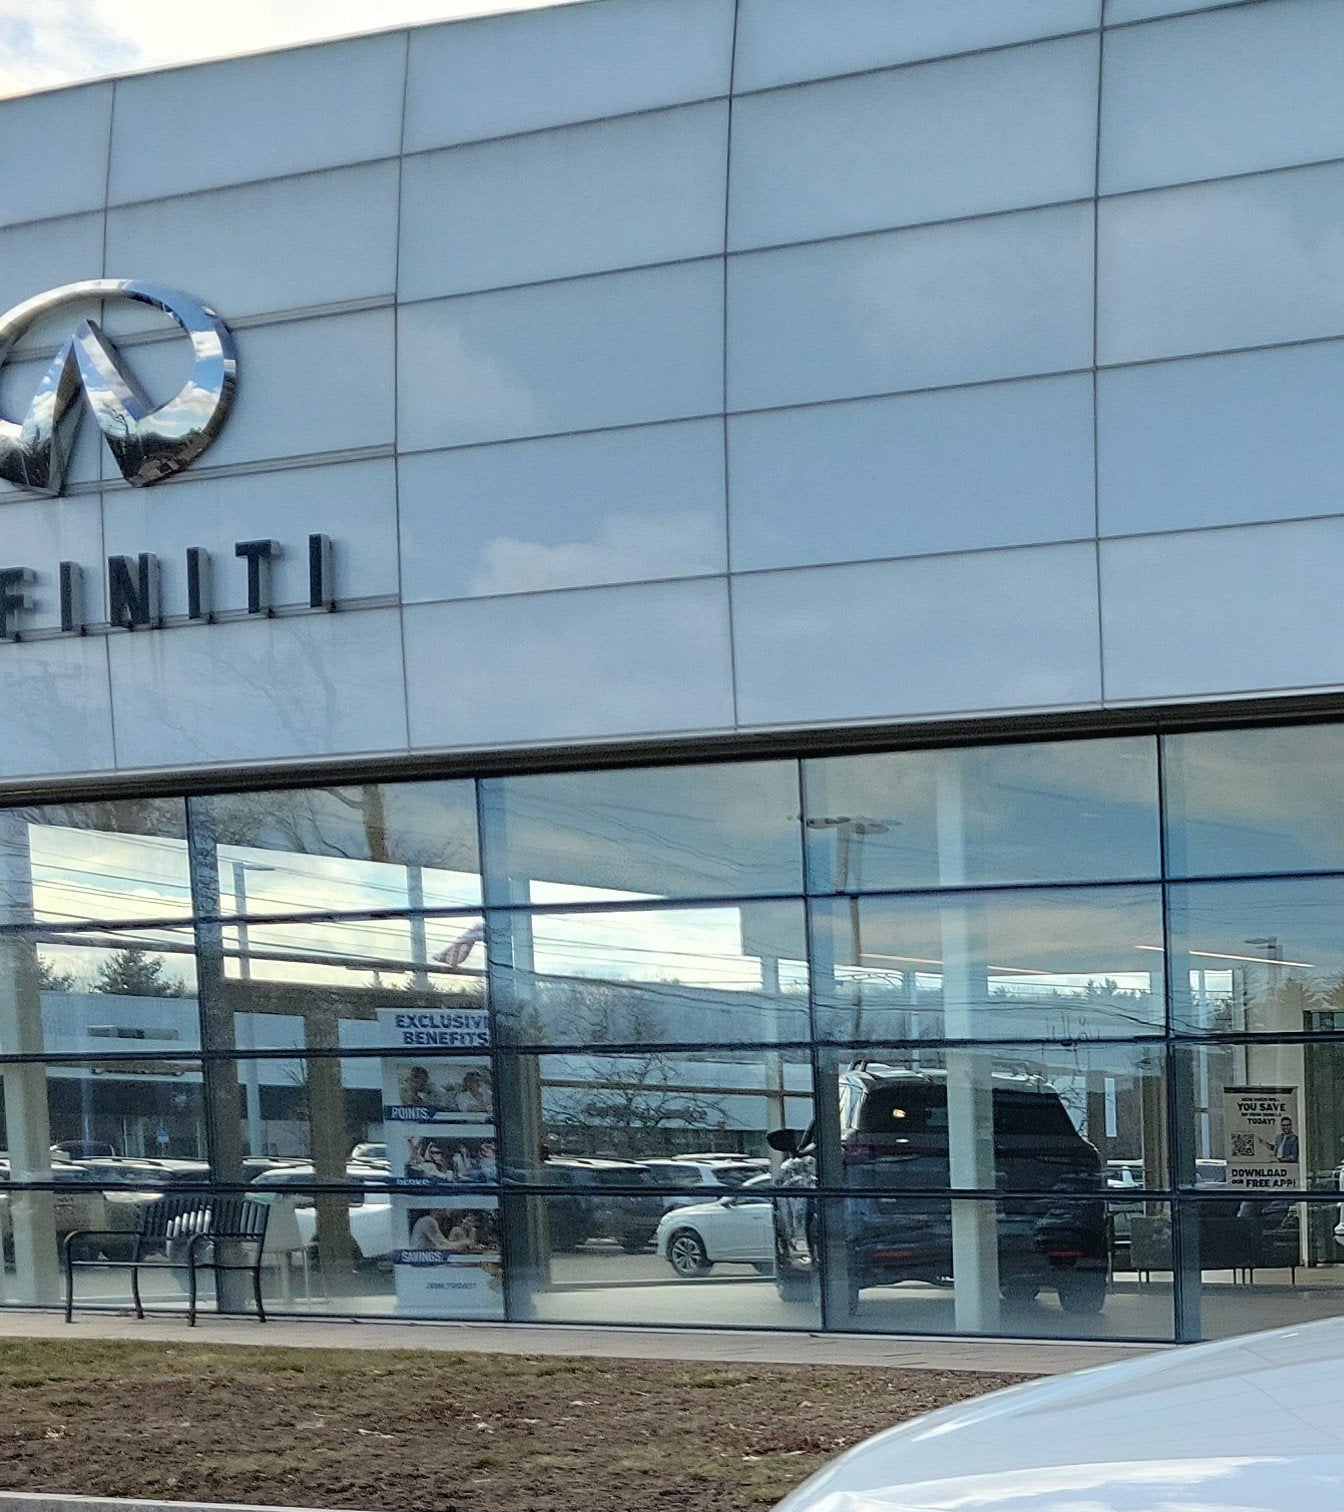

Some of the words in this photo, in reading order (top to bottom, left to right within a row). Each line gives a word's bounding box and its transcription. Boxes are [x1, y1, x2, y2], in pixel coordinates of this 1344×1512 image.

[403, 1031, 489, 1045] BENEFITS
[1237, 1102, 1257, 1112] YOU
[1259, 1102, 1286, 1112] SAVE
[1231, 1168, 1287, 1177] DOWNLOAD
[1246, 1179, 1271, 1188] FREE
